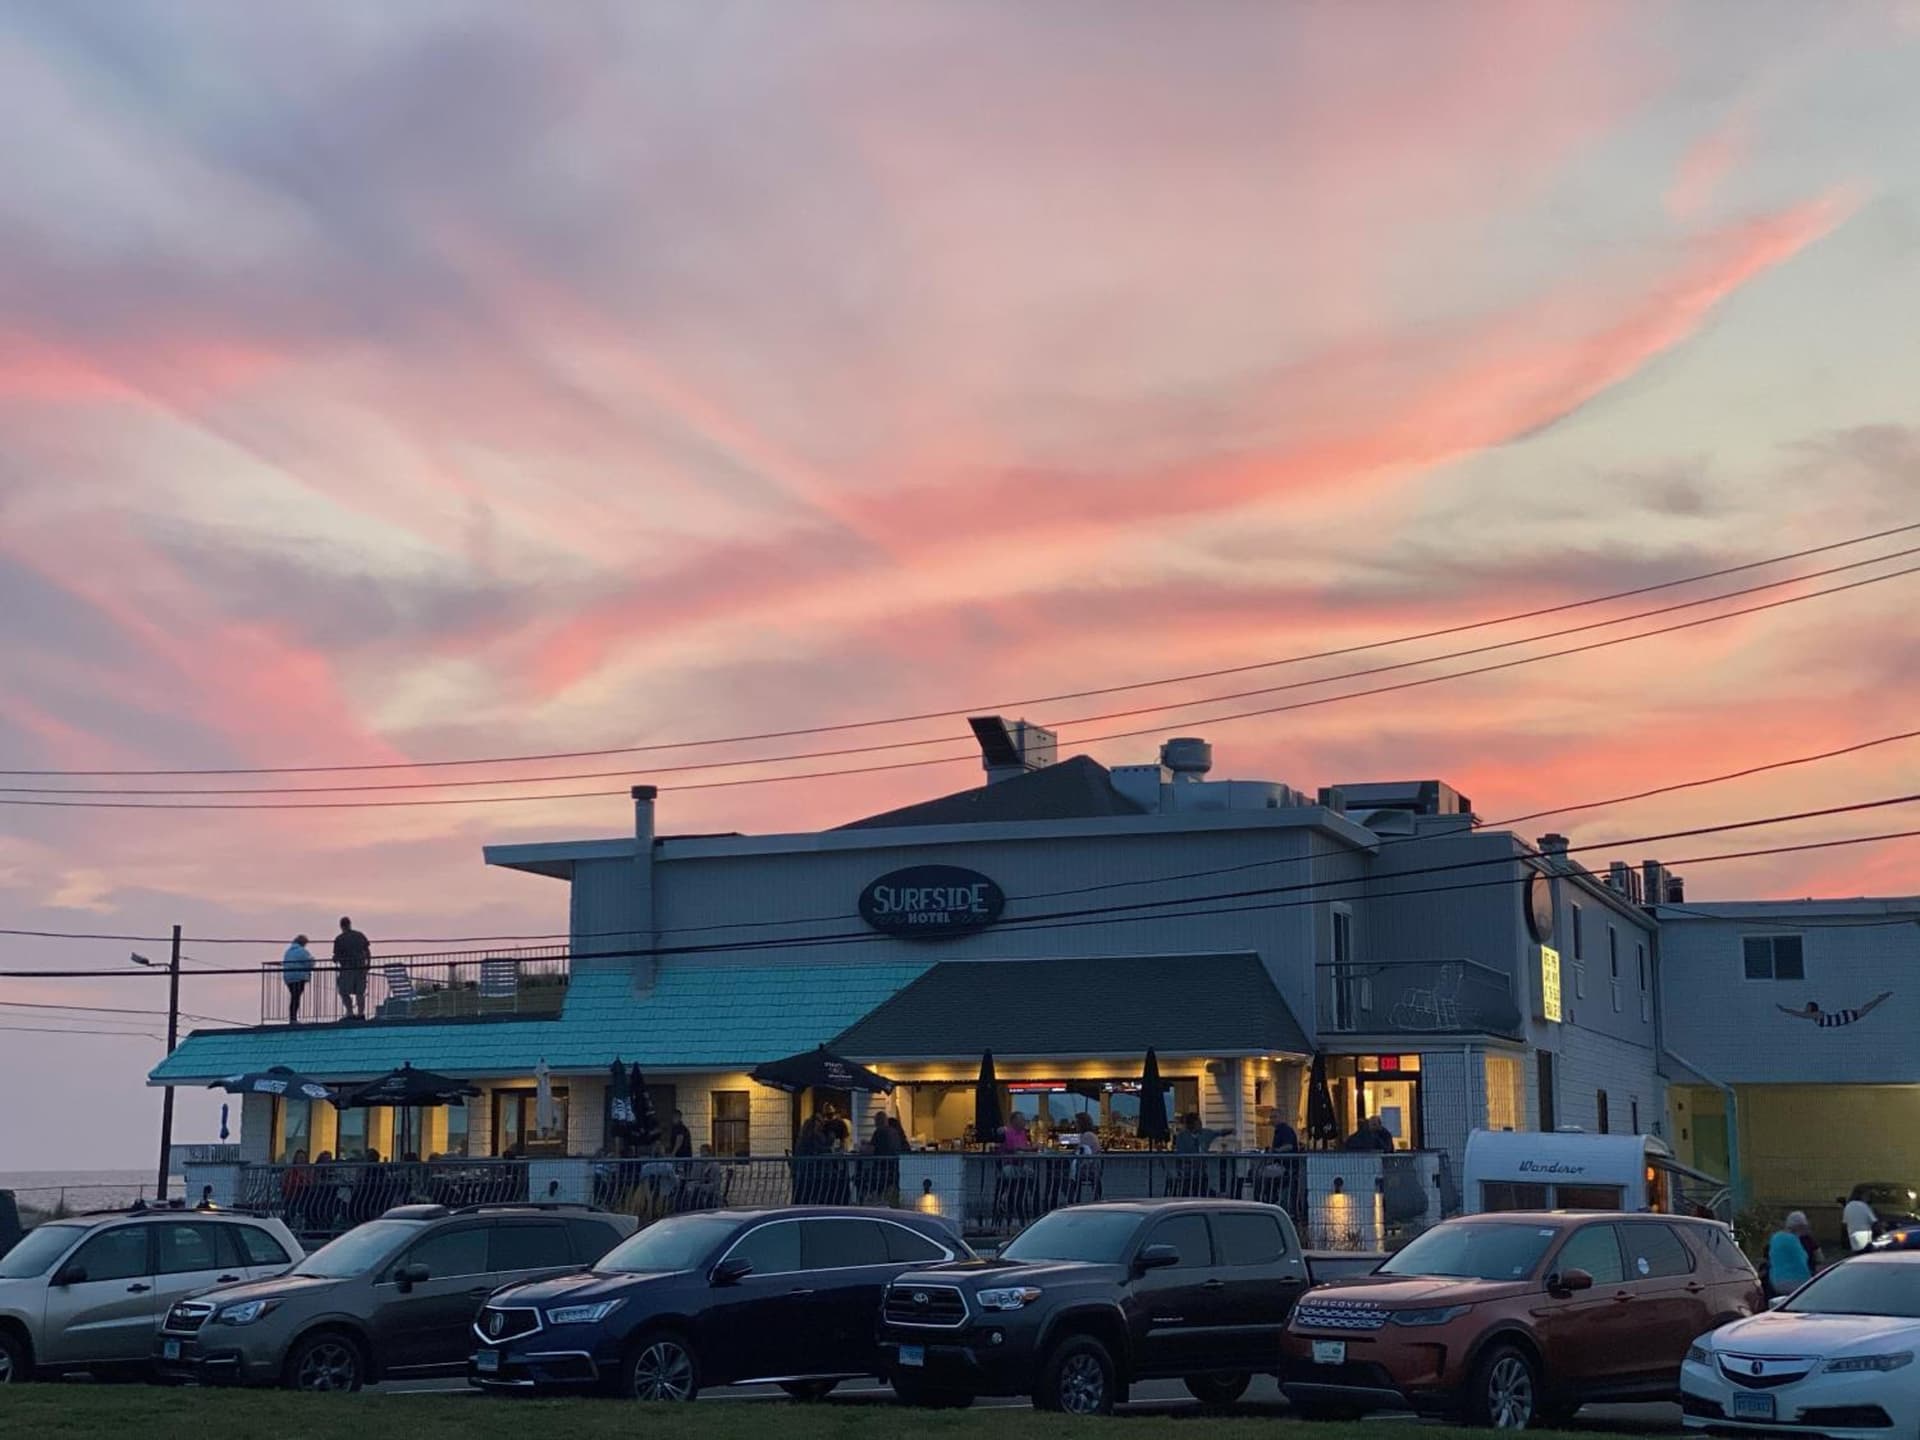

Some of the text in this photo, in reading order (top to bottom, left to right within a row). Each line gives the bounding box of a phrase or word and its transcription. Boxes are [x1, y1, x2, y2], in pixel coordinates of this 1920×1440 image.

[872, 884, 989, 913] SURFSIDE
[908, 911, 951, 923] HOTEL
[1519, 1160, 1586, 1175] Wanderer
[1310, 1299, 1379, 1309] DISCOVERY
